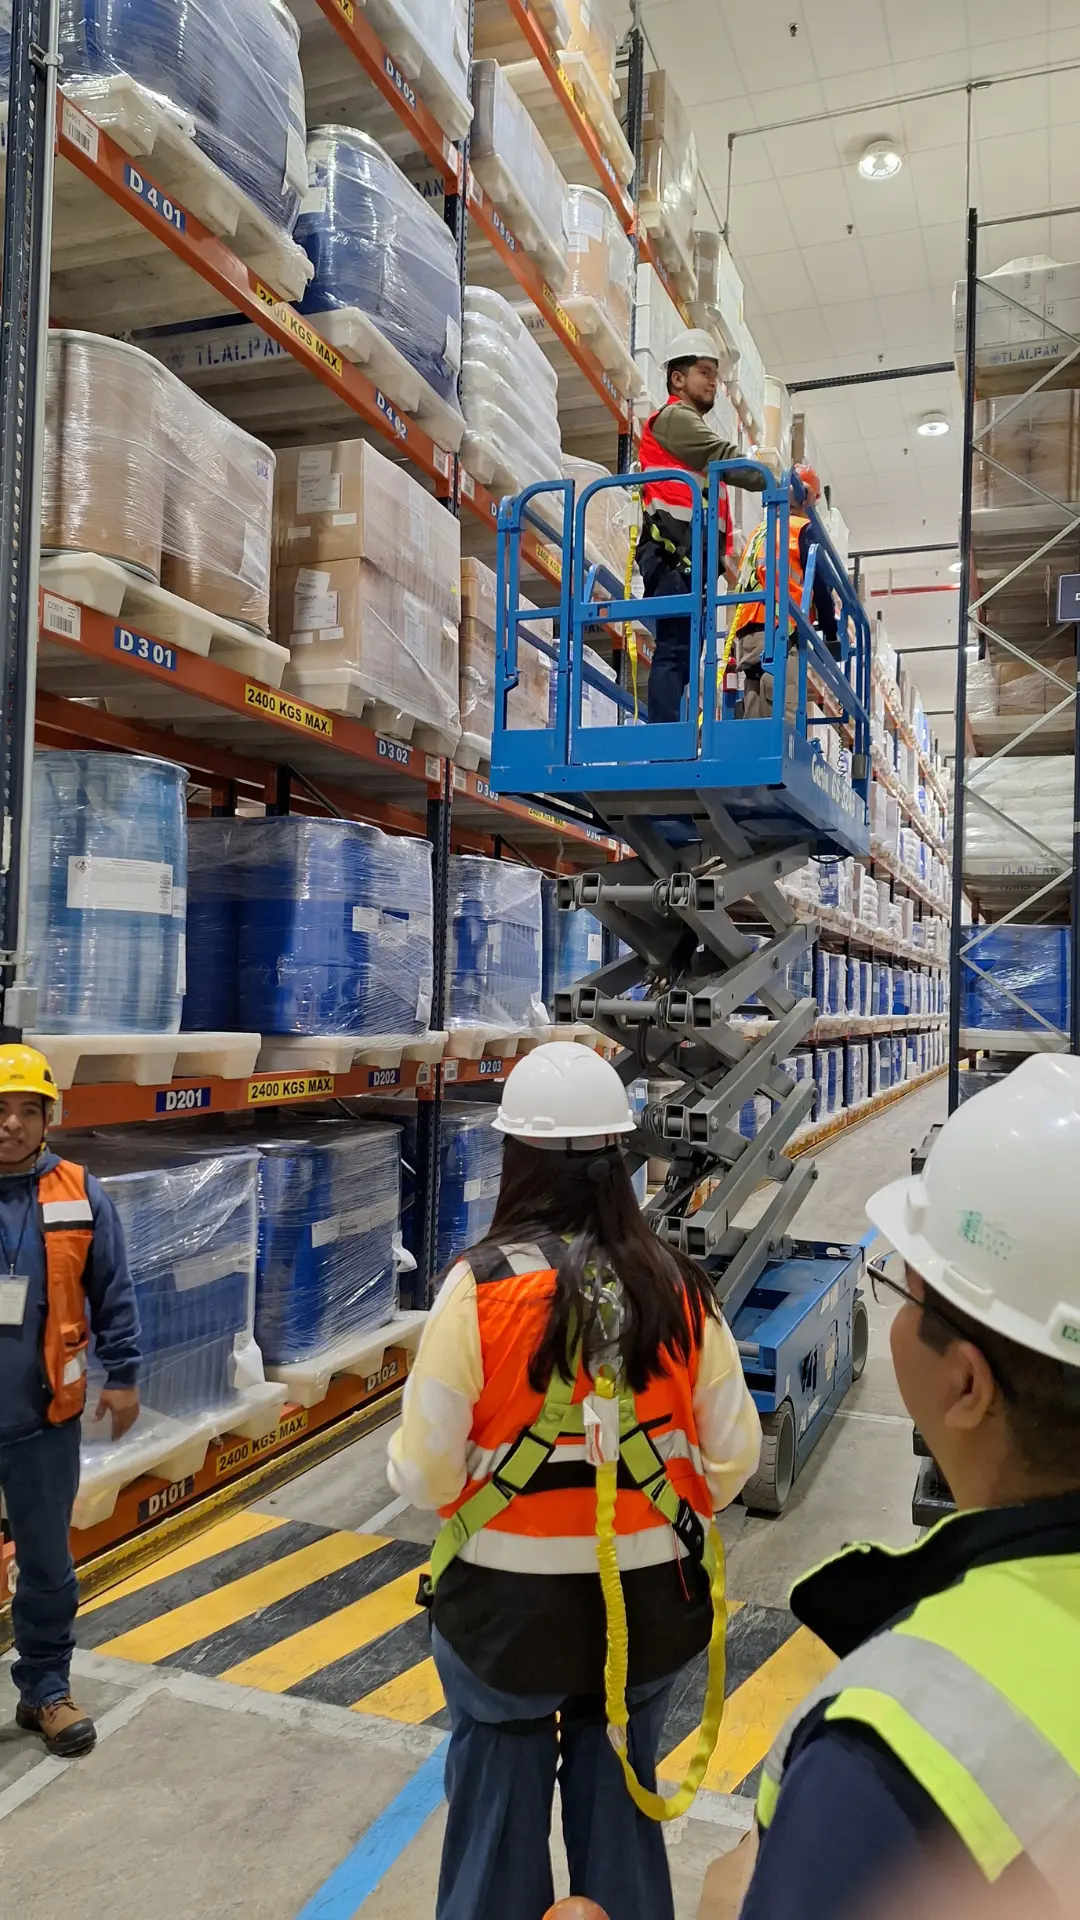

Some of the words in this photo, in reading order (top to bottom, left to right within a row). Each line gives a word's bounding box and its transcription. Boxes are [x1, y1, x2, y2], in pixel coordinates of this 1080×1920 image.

[290, 317, 313, 347] KGS
[315, 341, 342, 373] MAX.
[247, 688, 276, 711] 2400
[279, 700, 302, 722] KGS
[305, 713, 331, 735] MAX.
[251, 1083, 279, 1099] 2400
[282, 1081, 305, 1095] KGS
[308, 1077, 333, 1093] MAX.
[373, 1070, 396, 1086] D202
[165, 1088, 202, 1111] D201
[367, 1361, 397, 1391] D102
[218, 1443, 249, 1472] 2400
[252, 1430, 277, 1453] KGS
[279, 1416, 307, 1440] MAX.
[148, 1479, 187, 1517] D101
